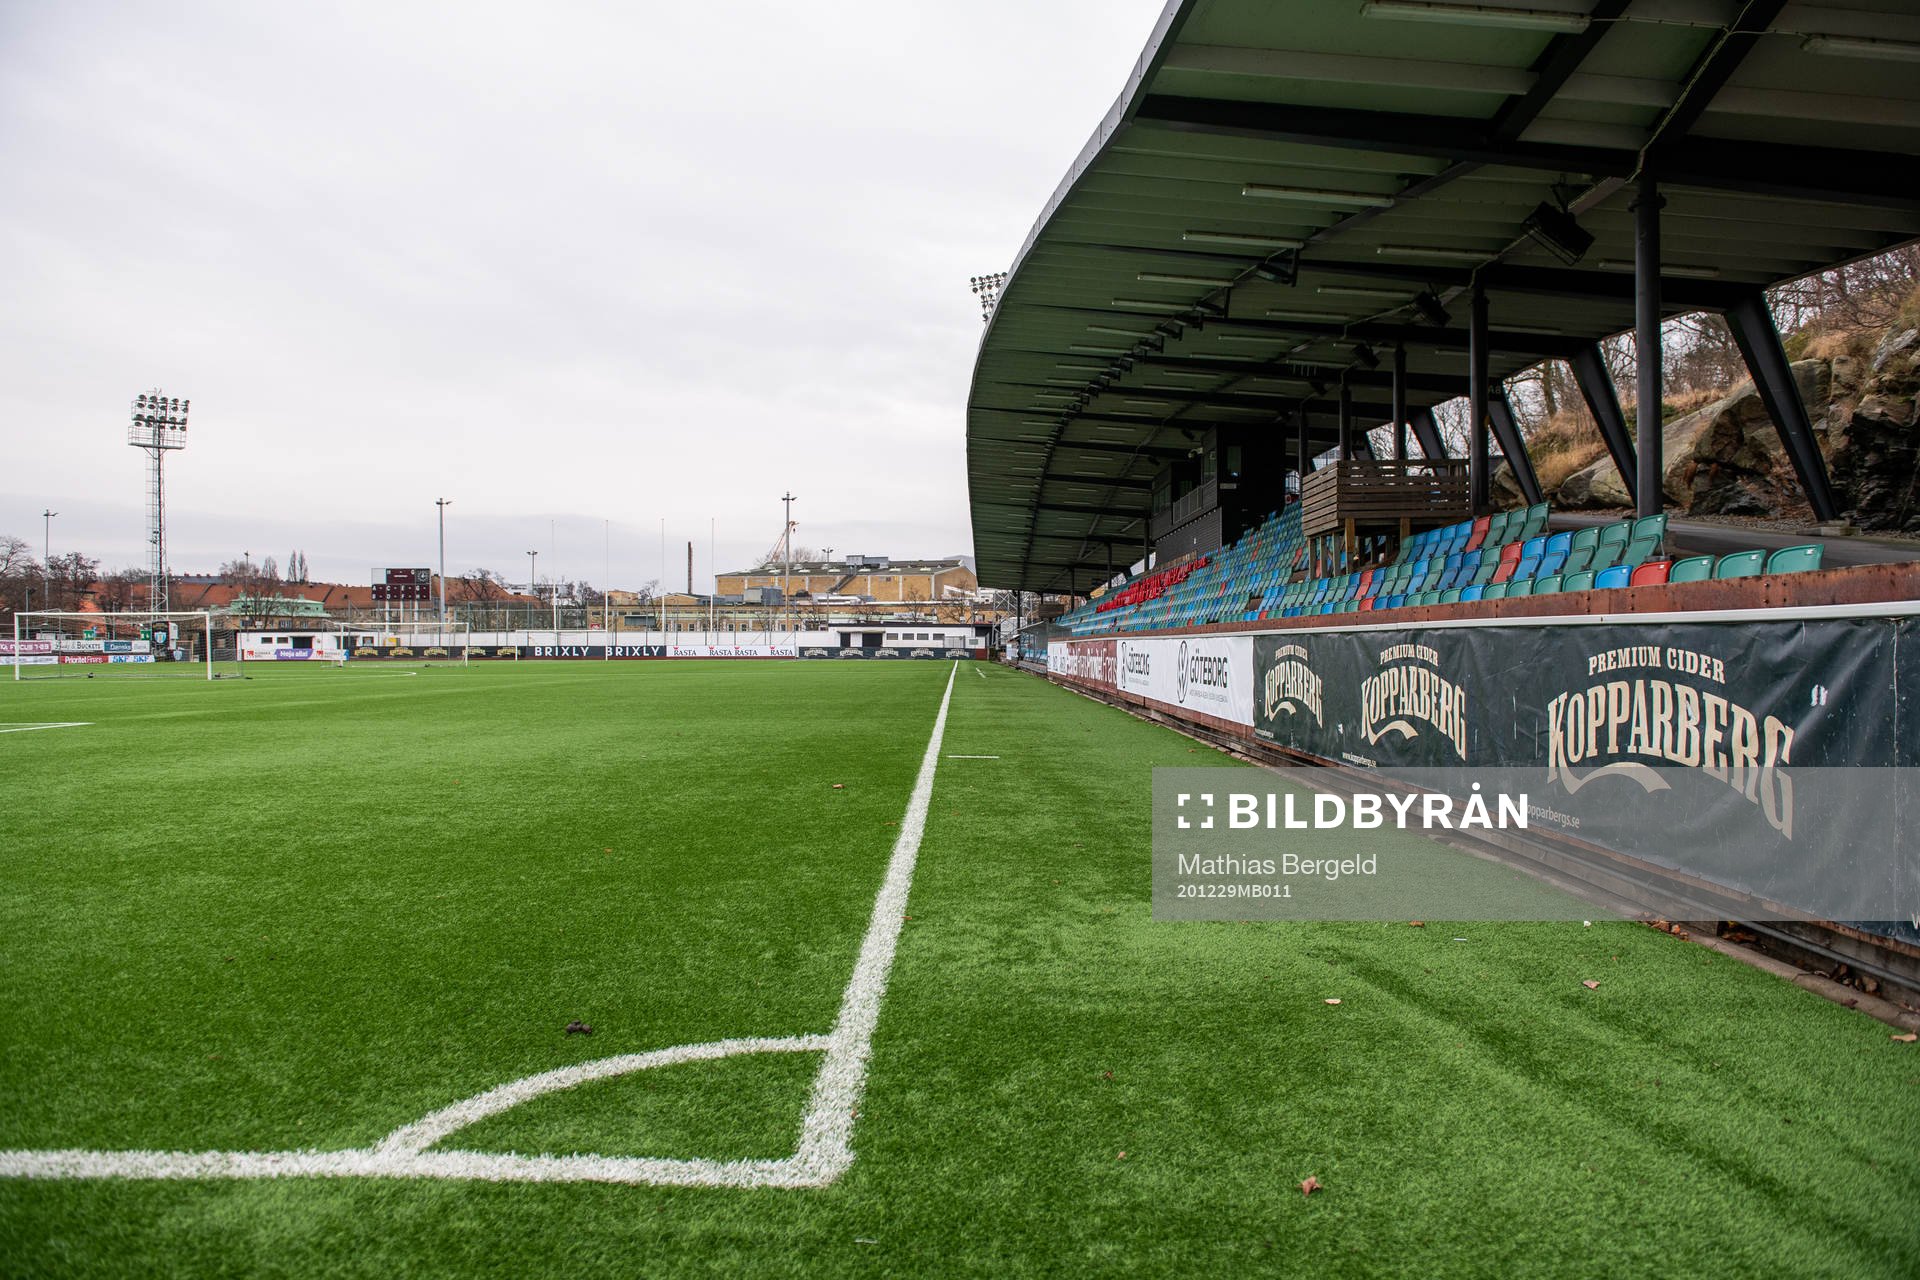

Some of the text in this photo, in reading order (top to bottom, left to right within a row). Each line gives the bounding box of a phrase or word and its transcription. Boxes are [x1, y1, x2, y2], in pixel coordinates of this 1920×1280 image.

[534, 646, 590, 657] BRIXLY
[607, 646, 660, 657] BRIXLY
[1128, 647, 1150, 676] GÖTEBORG
[1189, 647, 1228, 688] GÖTEBORG
[1380, 644, 1439, 667] PREMIUM CIDER
[1588, 646, 1726, 684] PREMIUM CIDER
[1264, 660, 1323, 729] KOPPARBERG
[1360, 665, 1467, 761] KOPPARBERG
[1547, 679, 1795, 841] KOPPARBERG
